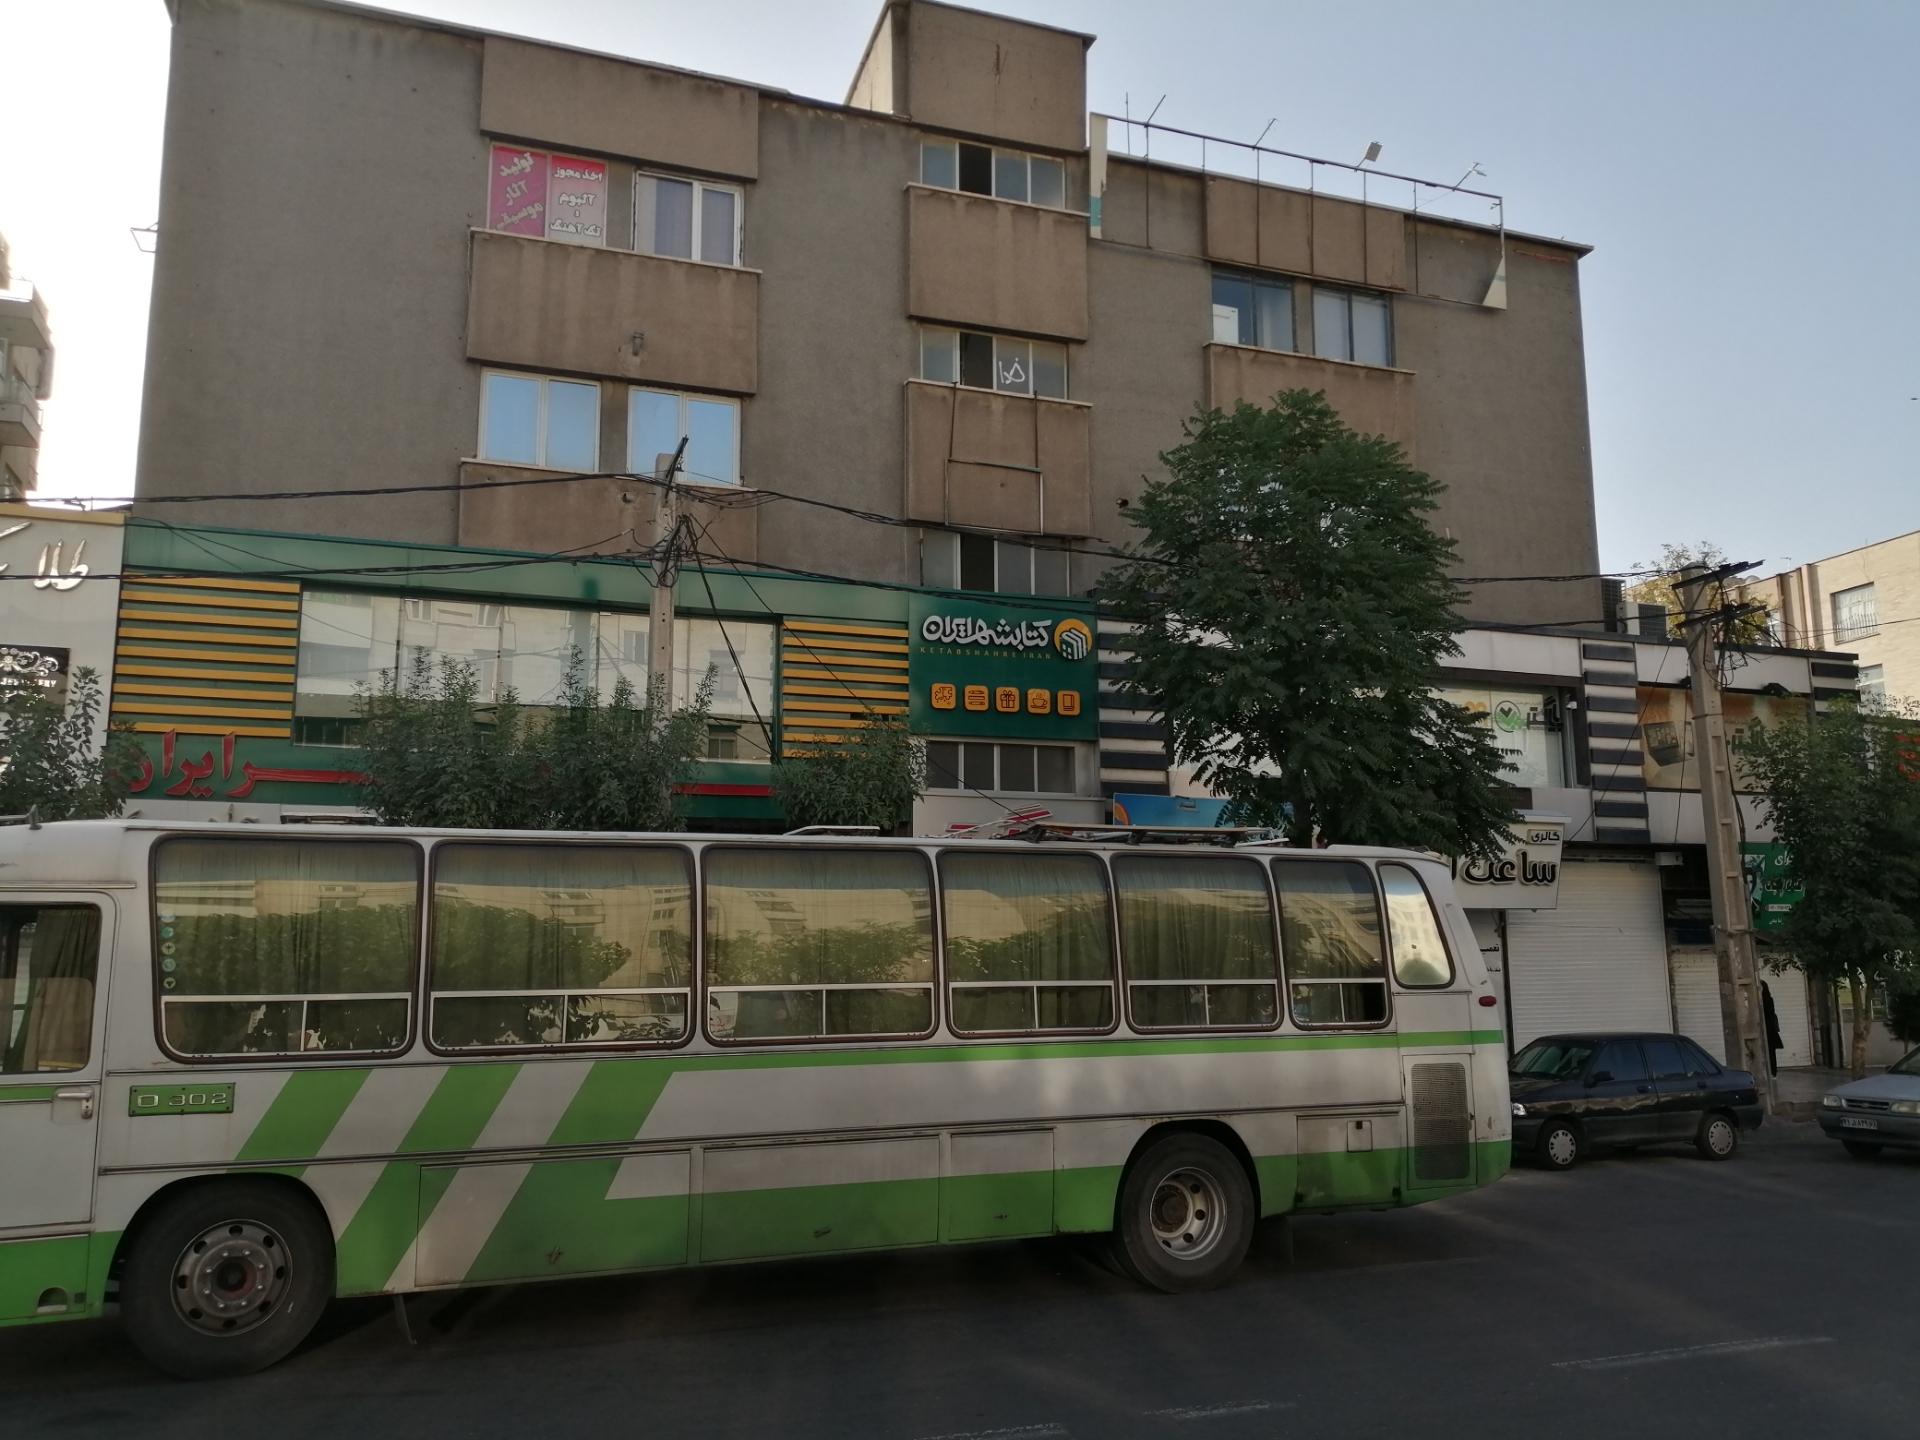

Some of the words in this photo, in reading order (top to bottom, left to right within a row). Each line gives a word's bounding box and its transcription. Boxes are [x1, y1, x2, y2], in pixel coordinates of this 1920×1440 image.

[499, 152, 534, 177] تولید
[554, 166, 581, 179] مجوز
[582, 169, 603, 182] اخذ
[559, 192, 596, 207] آلبوم
[33, 538, 89, 590] طلا
[922, 615, 972, 644] ایران
[920, 647, 1017, 658] KETABSHAHRE
[1023, 652, 1052, 660] IRAN
[168, 1092, 227, 1106] 302
